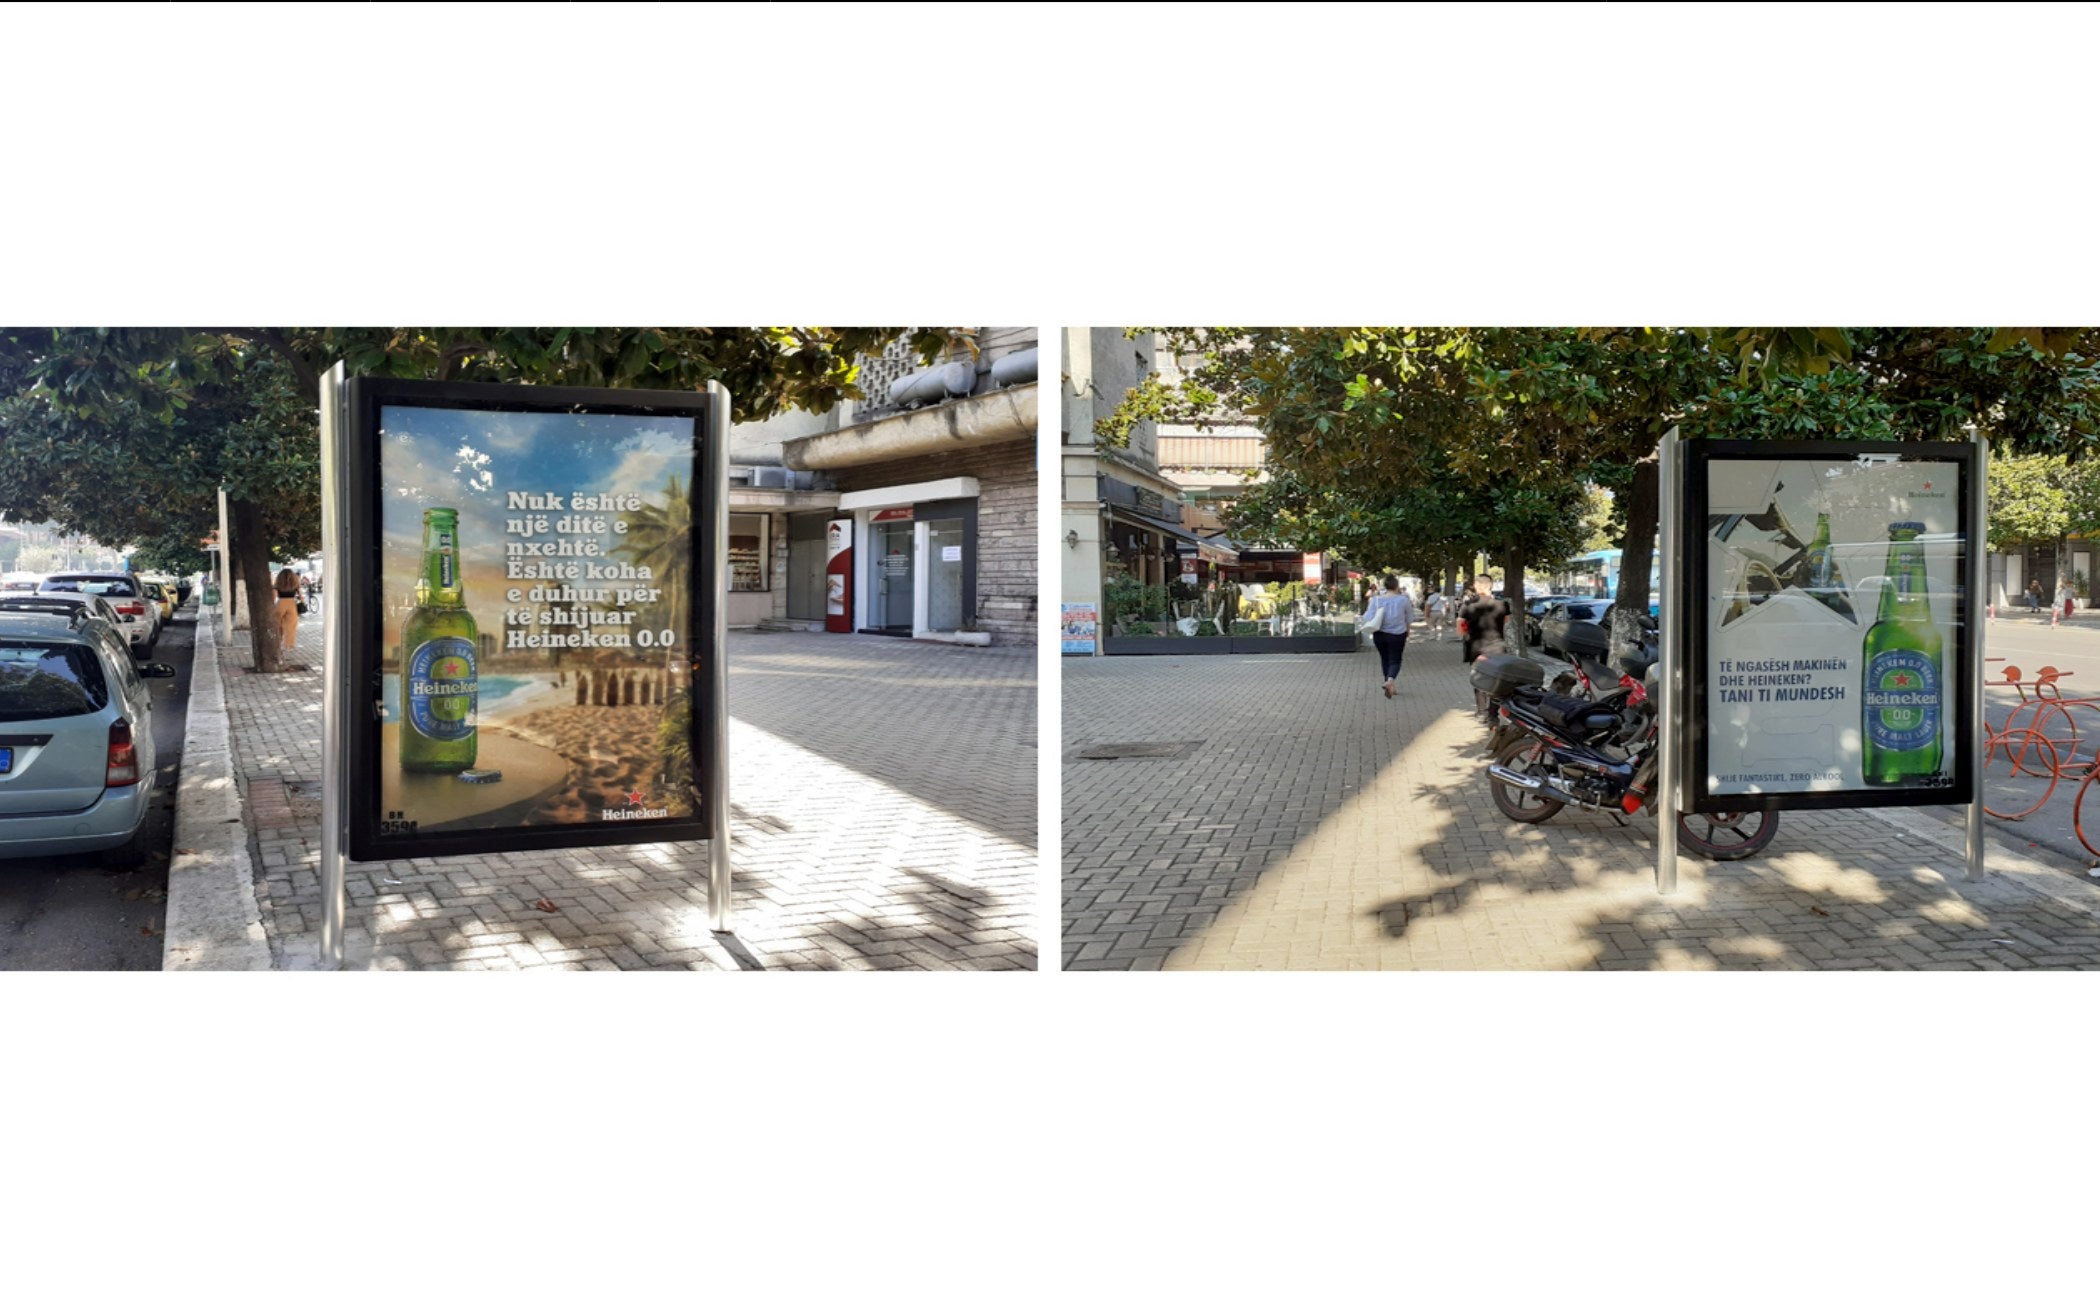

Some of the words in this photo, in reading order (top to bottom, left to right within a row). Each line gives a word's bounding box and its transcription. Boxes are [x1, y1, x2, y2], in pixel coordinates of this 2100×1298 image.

[507, 491, 564, 511] Nuk
[571, 492, 641, 512] është
[507, 515, 549, 537] një
[556, 515, 606, 534] ditë
[614, 521, 628, 534] e
[507, 539, 605, 556] nxehtë.
[507, 557, 579, 579] Është
[586, 562, 652, 579] koha
[507, 588, 521, 602] e
[529, 585, 609, 602] duhur
[616, 584, 661, 606] për
[507, 608, 532, 625] të
[539, 607, 636, 629] shijuar
[507, 630, 631, 648] Heineken
[637, 629, 675, 647] 0.0
[1720, 658, 1732, 672] TË
[1736, 657, 1790, 672] NGASËSH
[1793, 656, 1847, 671] MAKINËN
[1720, 675, 1744, 686] DHE
[1748, 673, 1812, 686] HEINEKEN?
[1720, 689, 1753, 702] TANI
[1758, 689, 1771, 702] TI
[1775, 686, 1845, 701] MUNDESH
[1866, 691, 1938, 705] Heineken
[602, 807, 668, 820] Heineken
